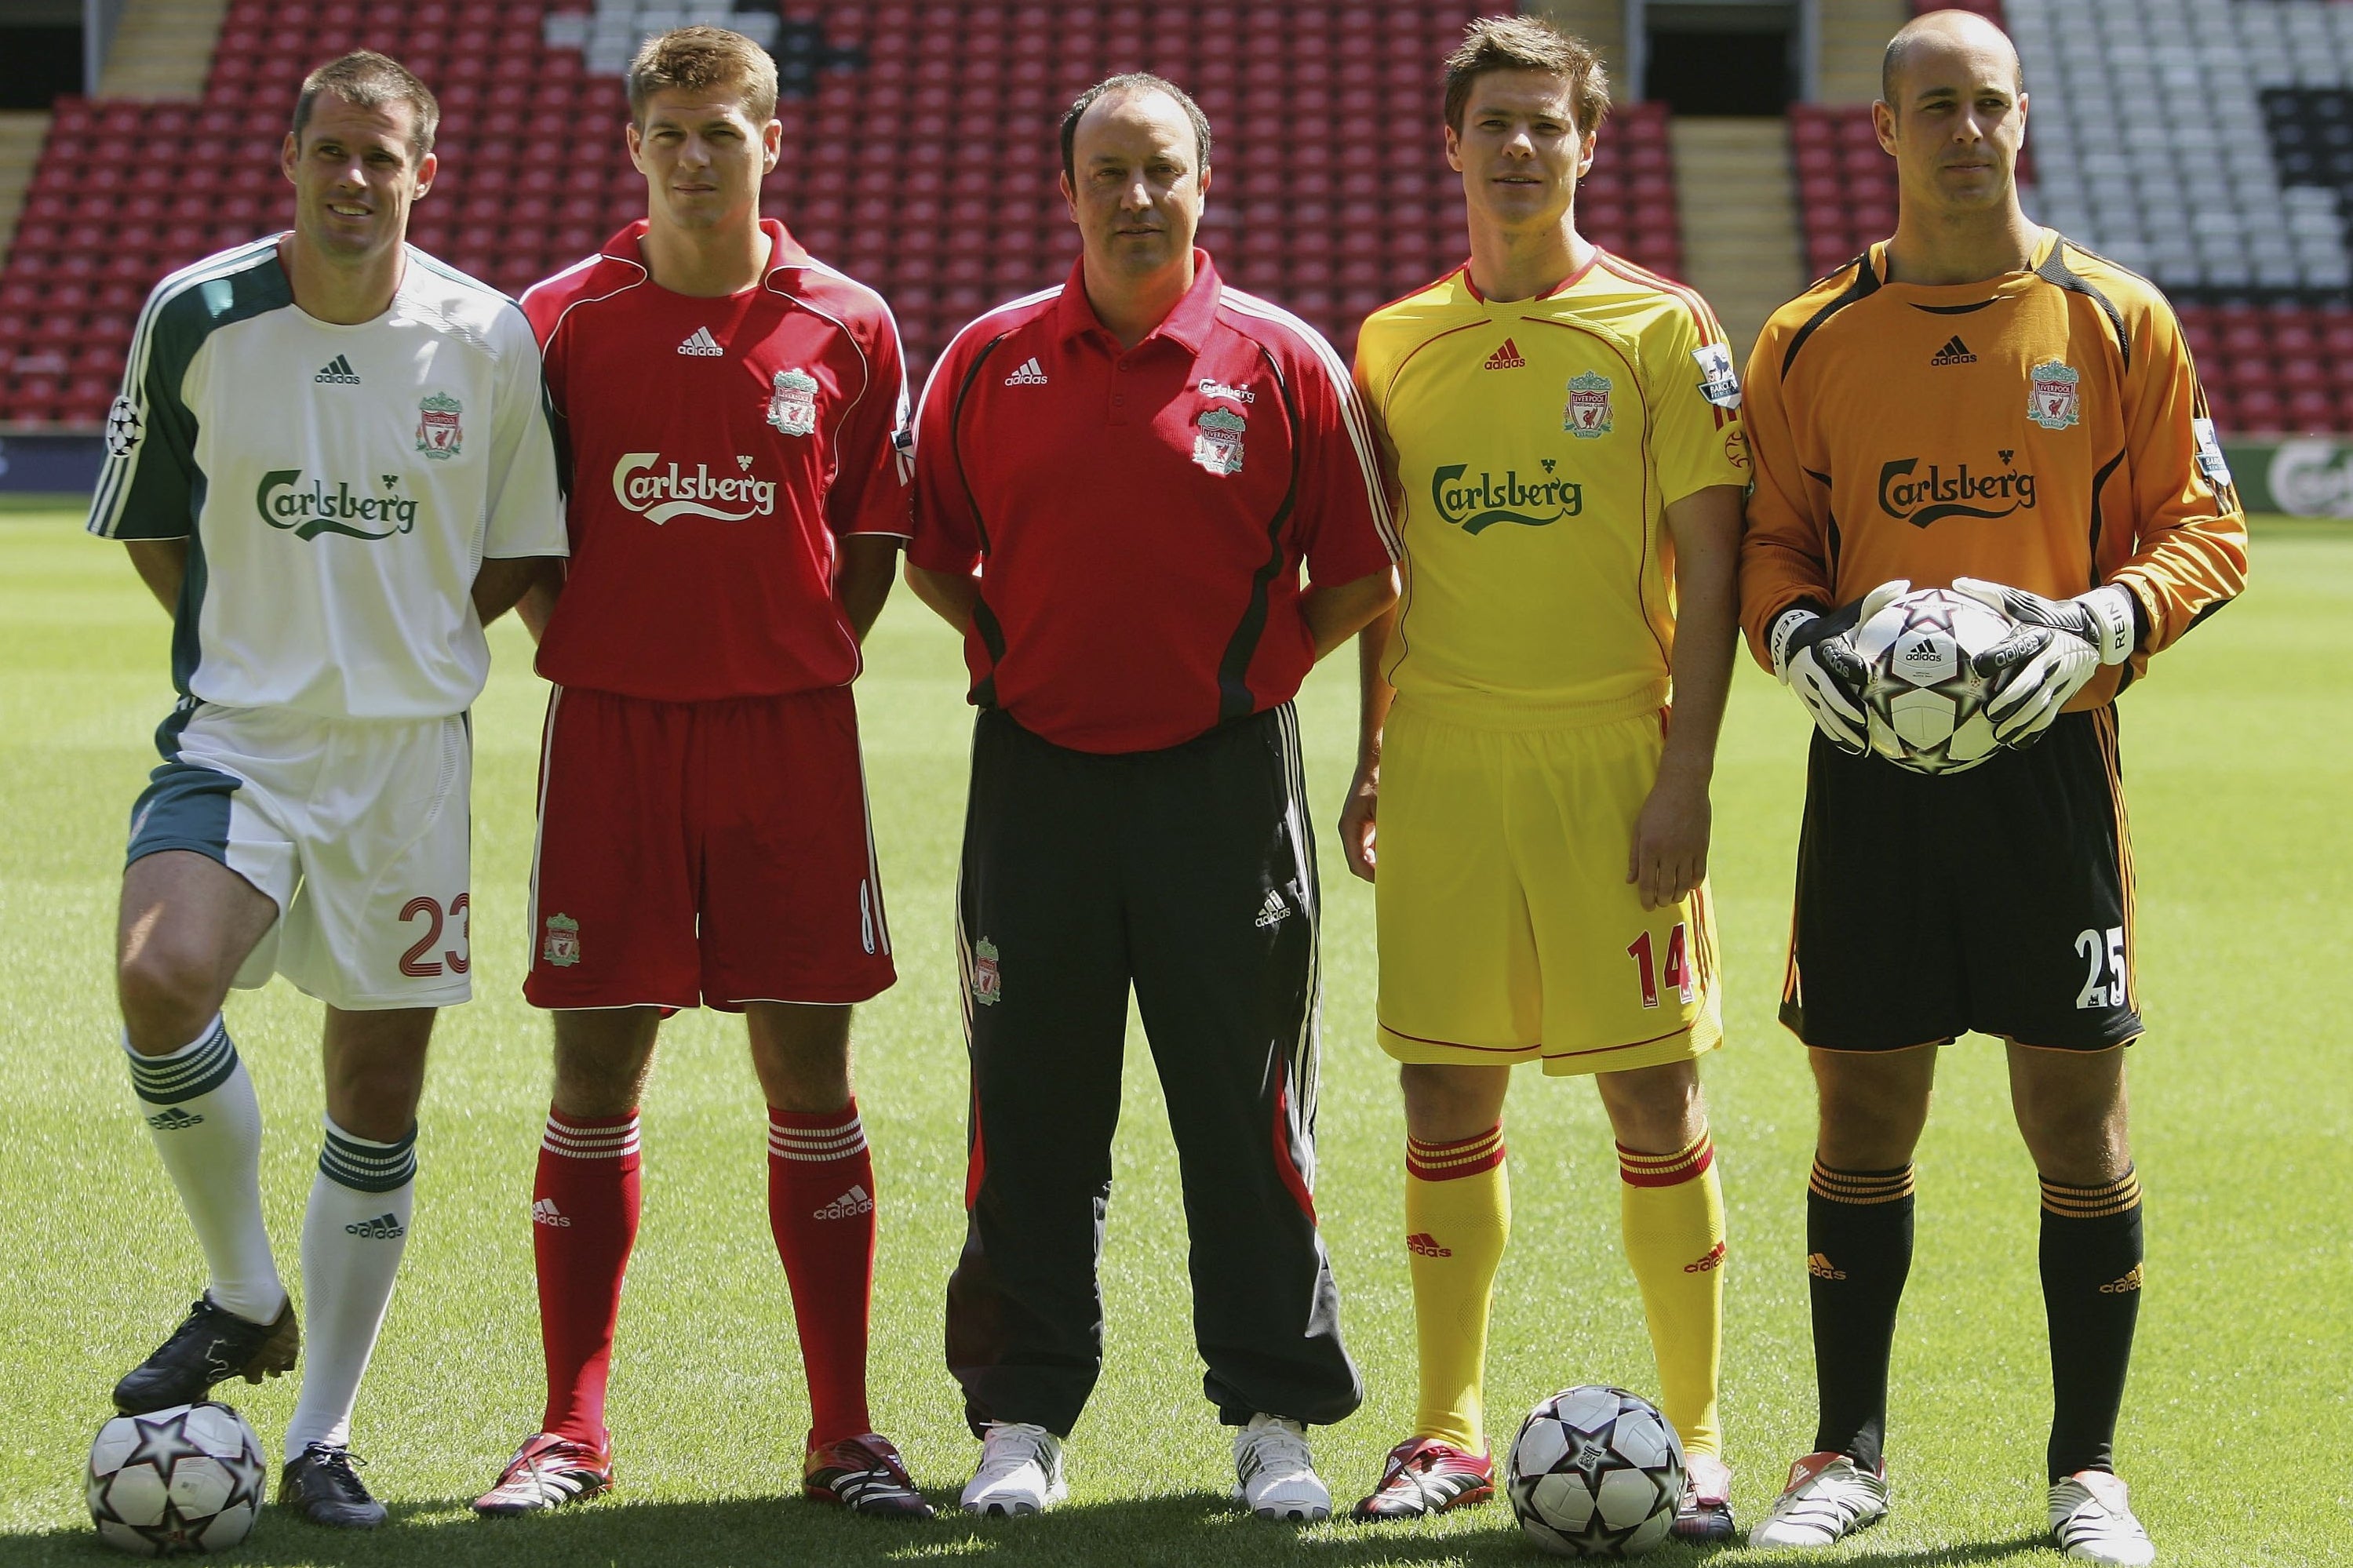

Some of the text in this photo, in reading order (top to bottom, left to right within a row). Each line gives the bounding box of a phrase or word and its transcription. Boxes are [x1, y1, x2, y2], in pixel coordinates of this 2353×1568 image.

[676, 344, 723, 356] adidas
[1931, 353, 1977, 366] adidas
[1484, 358, 1526, 370] adidas
[315, 373, 361, 384] adidas
[1005, 374, 1048, 386] adidas
[1199, 378, 1255, 403] Carlsberg
[613, 453, 777, 518] Carlsberg
[1432, 464, 1583, 527] Carlsberg
[1878, 457, 2036, 522] Carlsberg
[257, 470, 419, 535] Carlsberg
[1906, 651, 1942, 662] adidas
[1994, 634, 2040, 667] adidas
[860, 879, 875, 955] 8
[1255, 907, 1291, 927] adidas
[399, 893, 470, 977] 23
[1626, 922, 1695, 1009] 14
[2074, 926, 2126, 1010] 25
[814, 1198, 873, 1220] adidas
[345, 1224, 404, 1239] adidas
